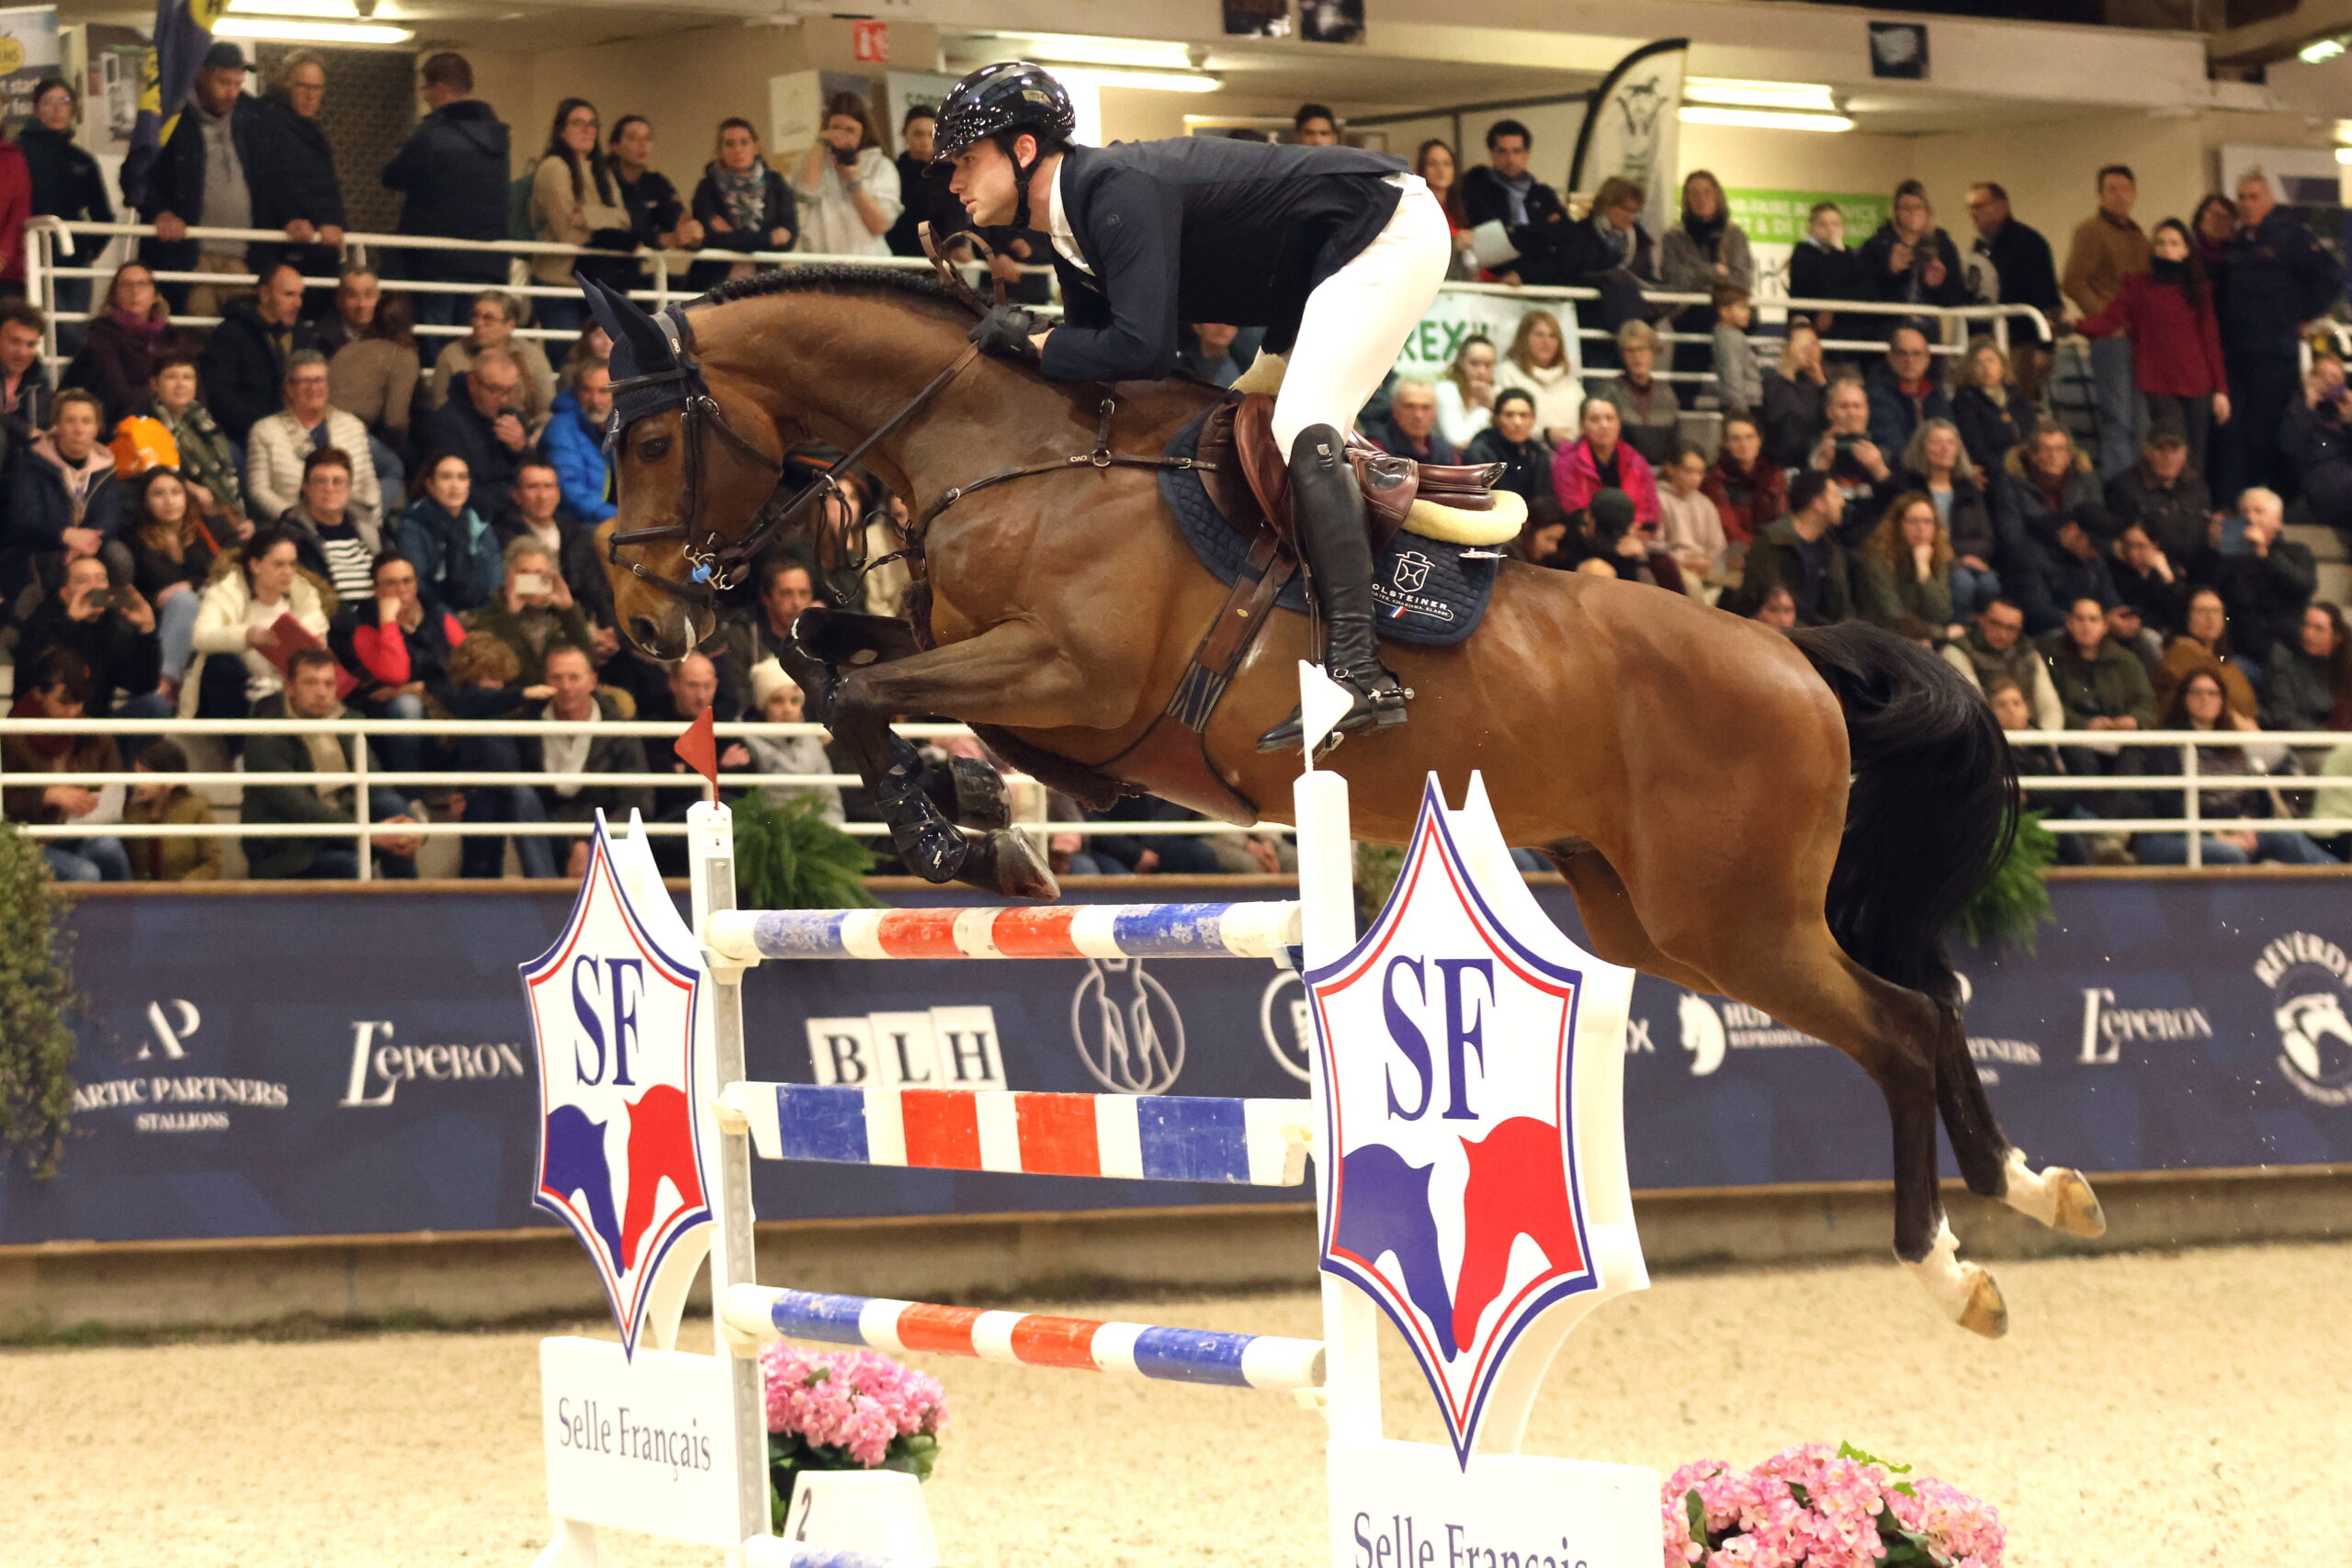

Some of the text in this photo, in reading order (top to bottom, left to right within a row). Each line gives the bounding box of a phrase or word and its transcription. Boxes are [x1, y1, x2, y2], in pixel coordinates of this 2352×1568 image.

[1372, 583, 1448, 610] OLSTEINER
[571, 953, 645, 1087] SF
[1383, 954, 1496, 1122] SF
[824, 1032, 996, 1085] BLH
[150, 1076, 288, 1109] PARTNERS
[136, 1111, 230, 1133] STALLIONS
[559, 1396, 712, 1483] Selle Français
[796, 1486, 812, 1542] 2
[1353, 1511, 1435, 1568] Selle
